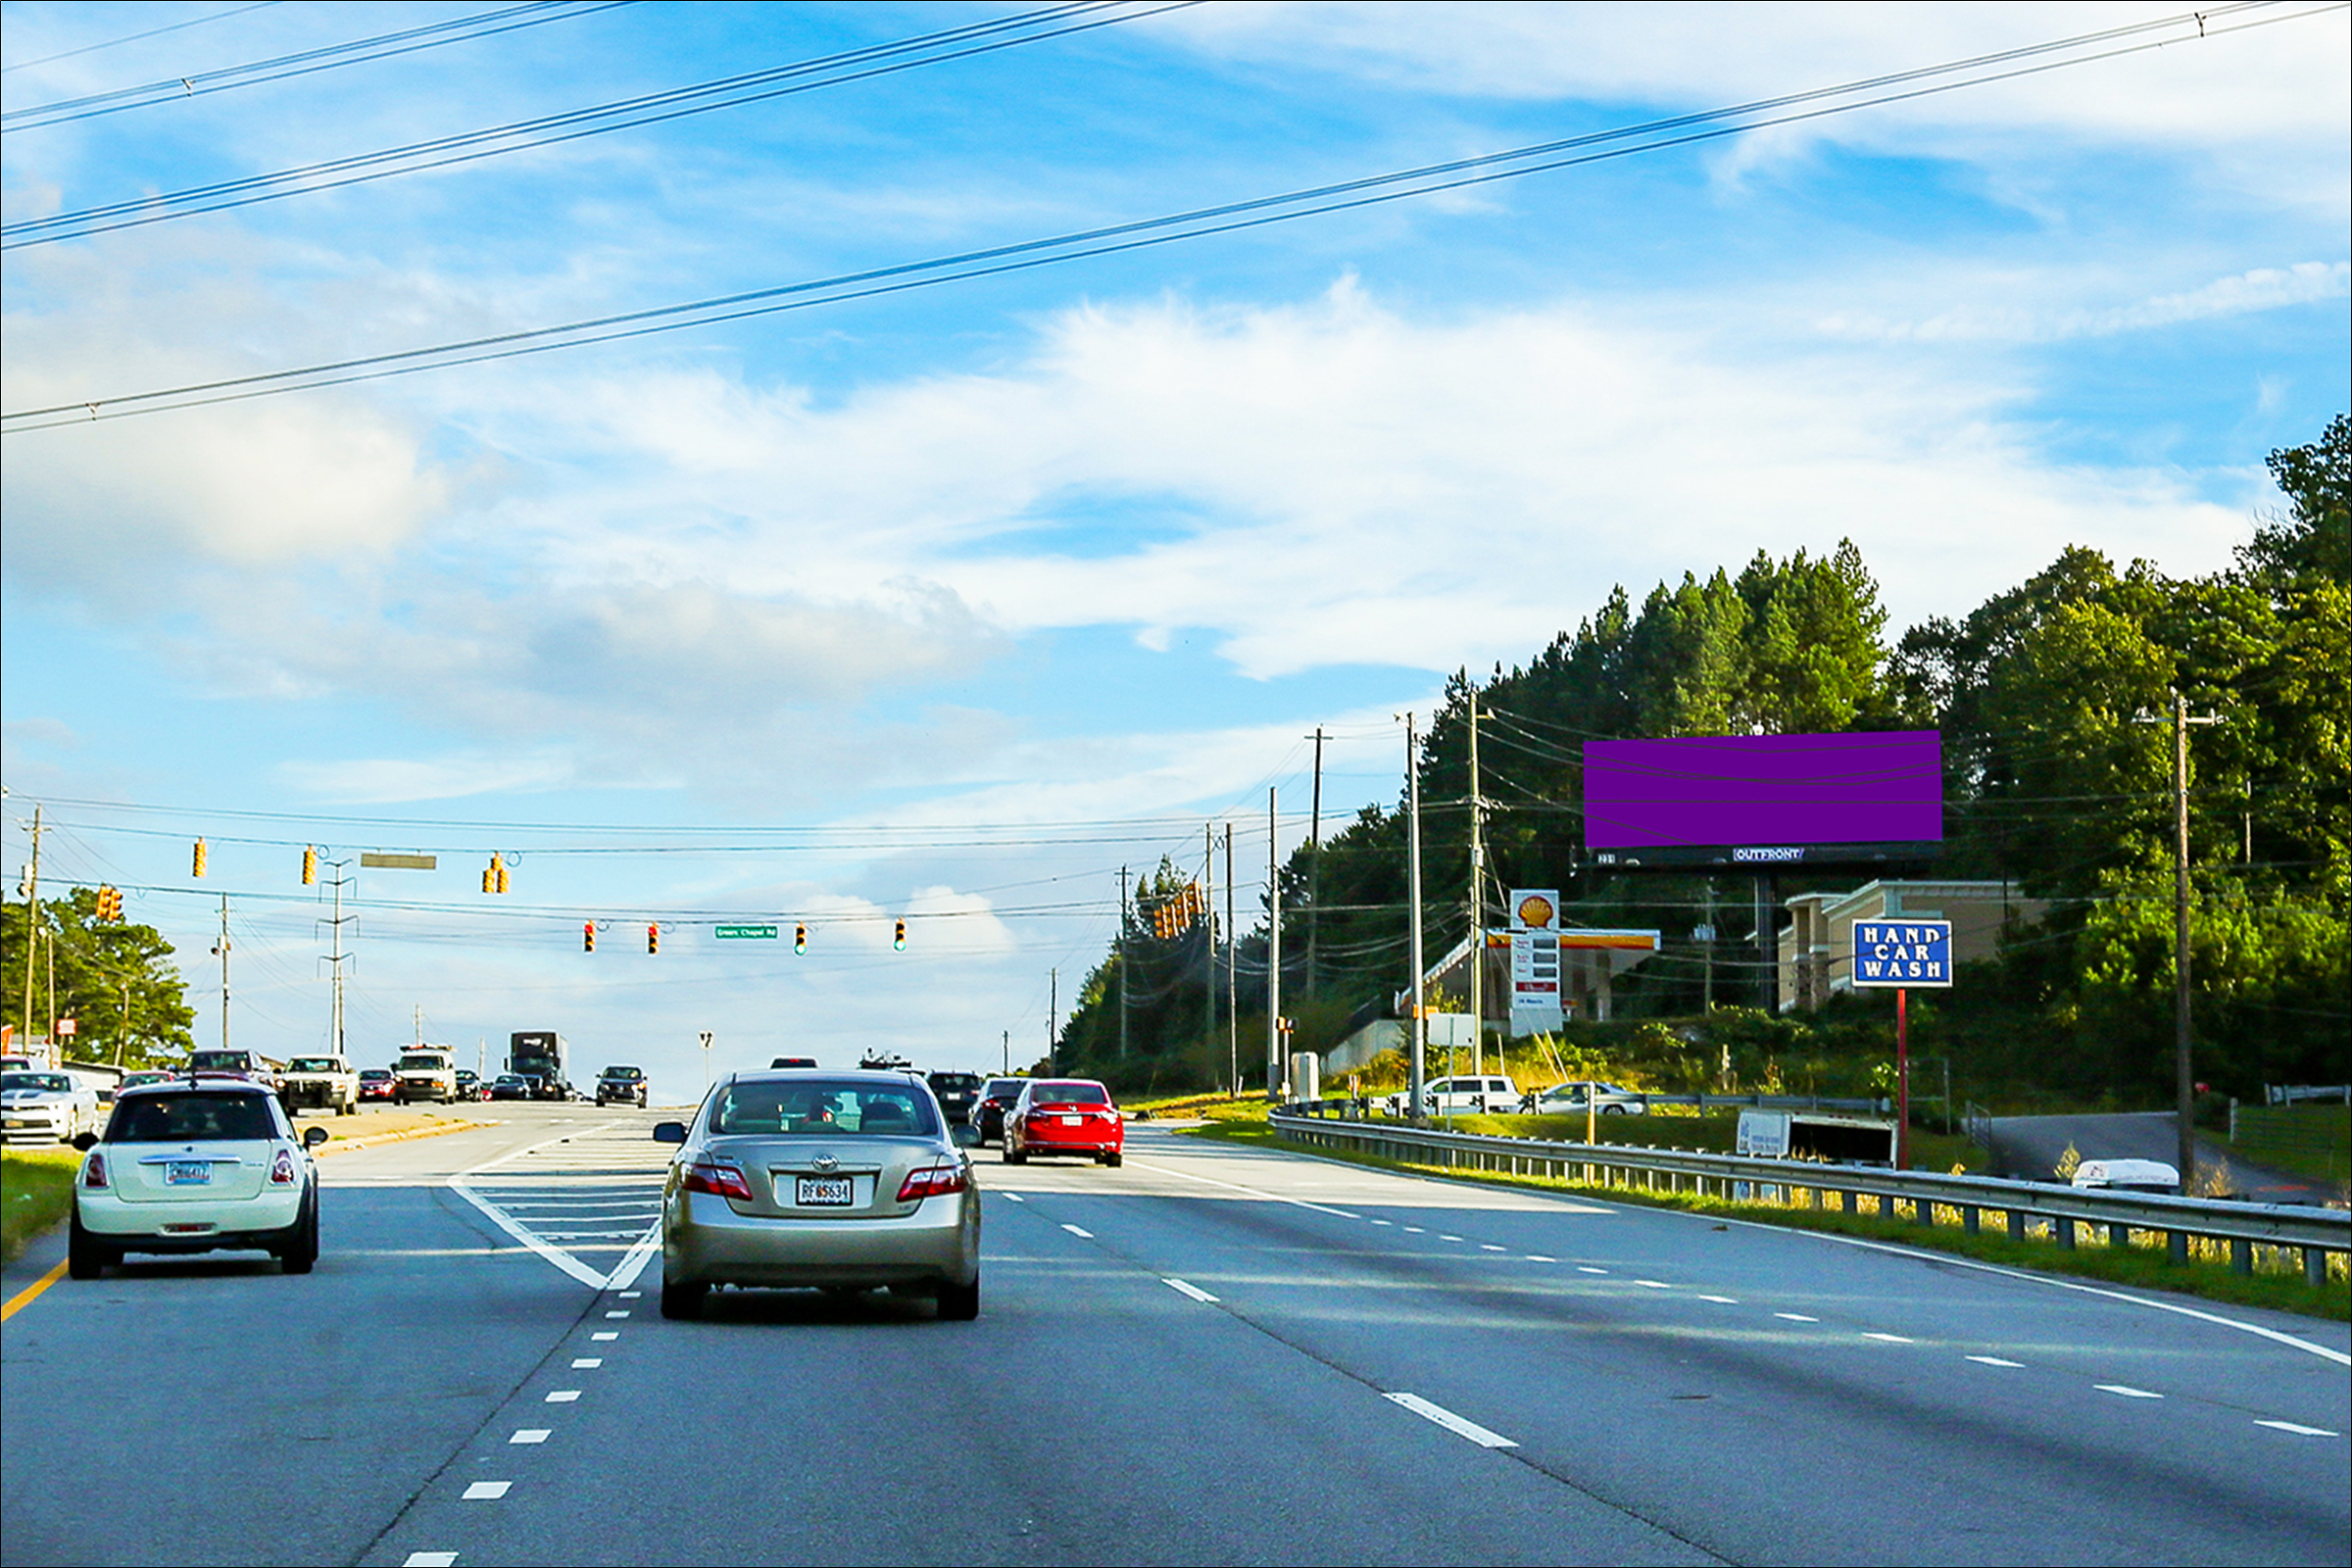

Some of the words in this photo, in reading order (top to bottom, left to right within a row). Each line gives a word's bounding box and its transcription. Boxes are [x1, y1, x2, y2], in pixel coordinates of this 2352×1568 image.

[1736, 848, 1800, 860] OUTFRONT
[1864, 927, 1939, 944] HAND
[1874, 944, 1930, 960] CAR
[1864, 961, 1940, 978] WASH
